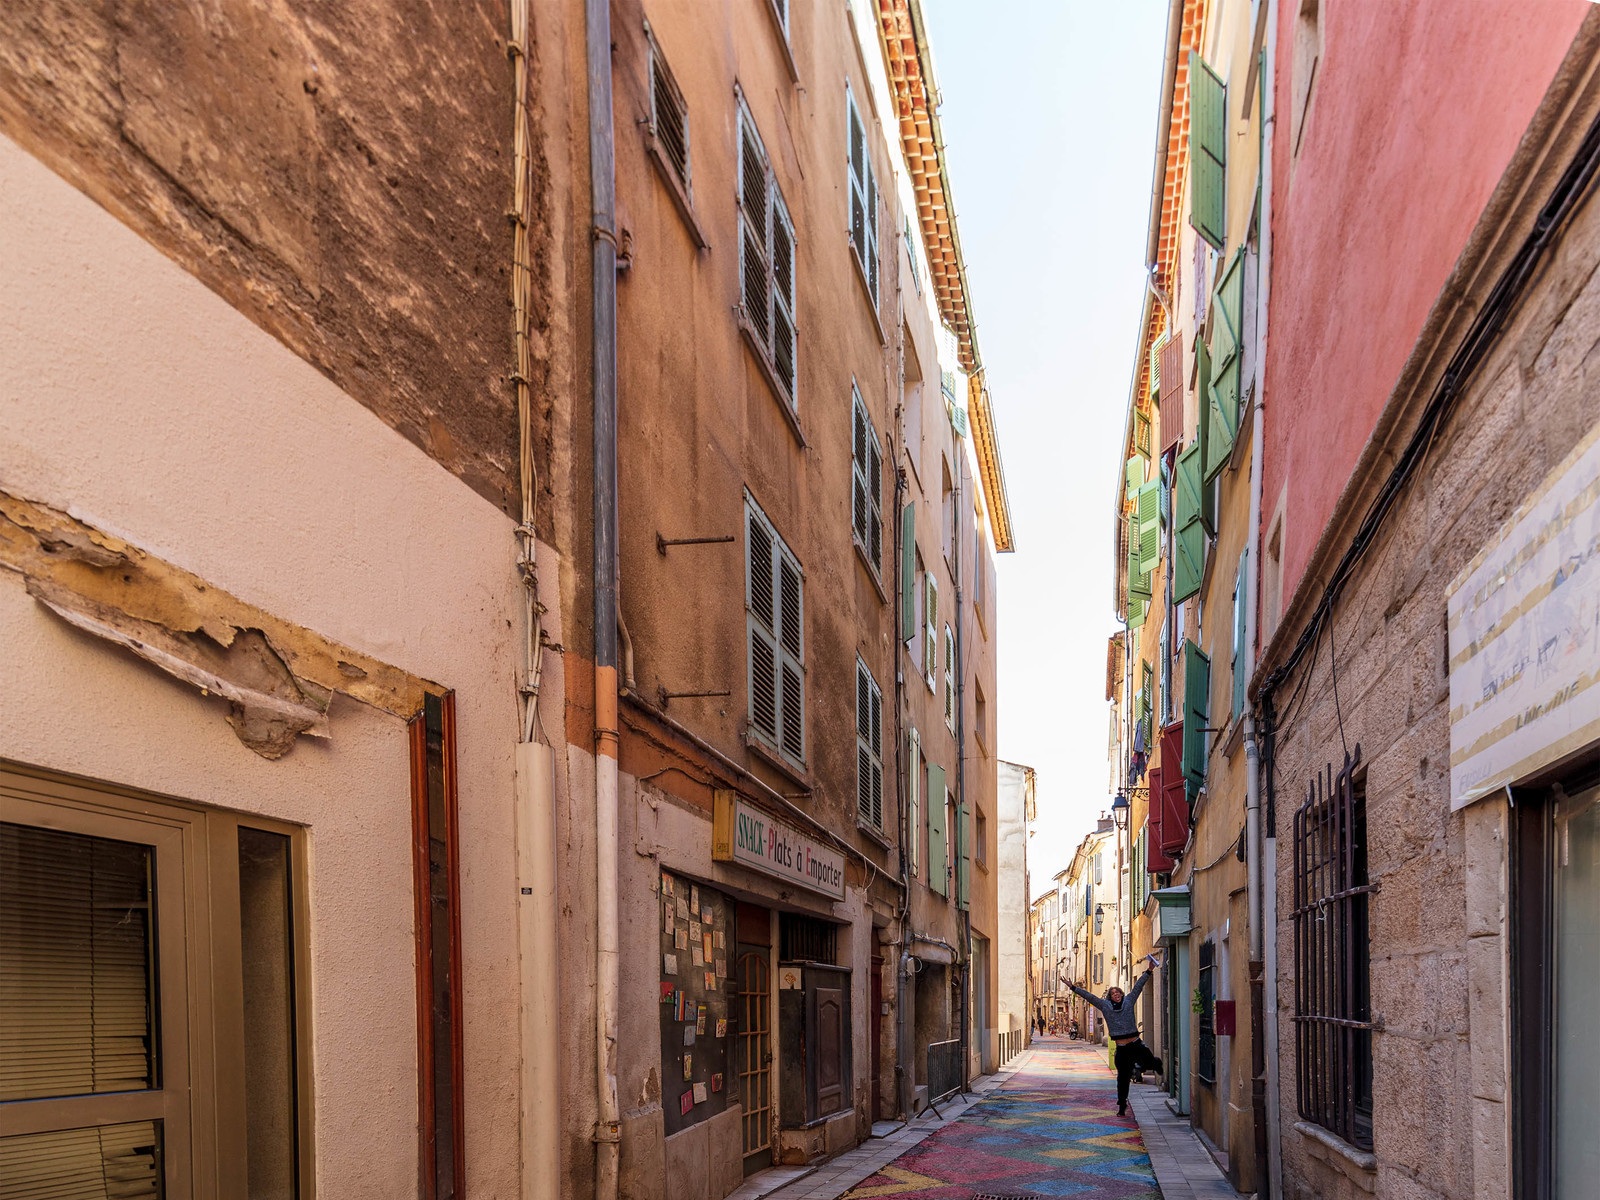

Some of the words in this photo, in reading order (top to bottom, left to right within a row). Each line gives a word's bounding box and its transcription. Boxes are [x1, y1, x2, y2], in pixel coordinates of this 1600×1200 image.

[768, 827, 792, 868] Plats
[796, 846, 802, 872] à
[806, 846, 842, 888] Emporter
